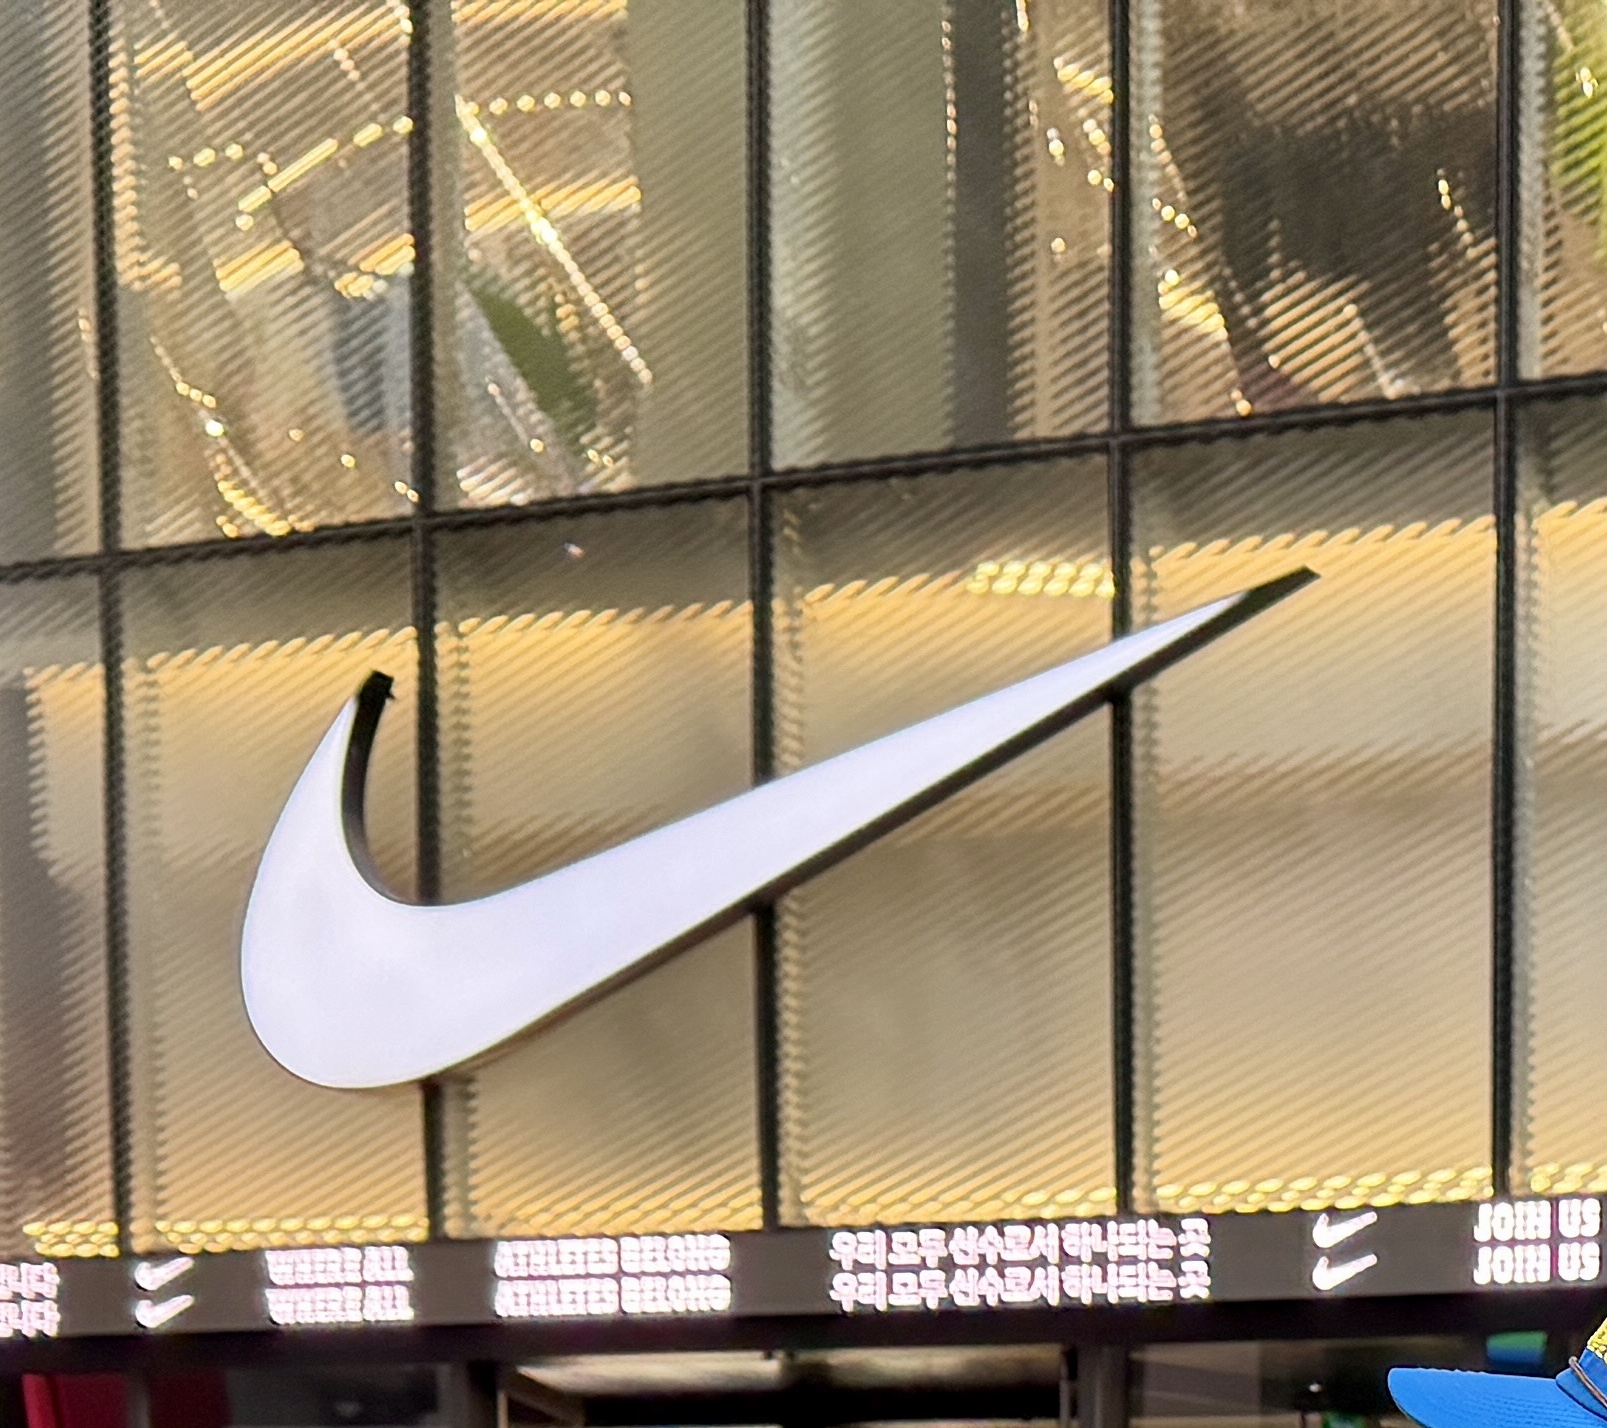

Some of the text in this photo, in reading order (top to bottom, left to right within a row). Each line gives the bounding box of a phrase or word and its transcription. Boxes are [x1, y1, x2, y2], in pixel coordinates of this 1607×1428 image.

[1474, 1198, 1600, 1242] JOIN US
[829, 1230, 887, 1270] 우리
[888, 1229, 948, 1268] 모두
[1474, 1241, 1599, 1285] JOIN US
[829, 1272, 887, 1311] 우리
[888, 1270, 948, 1309] 모두
